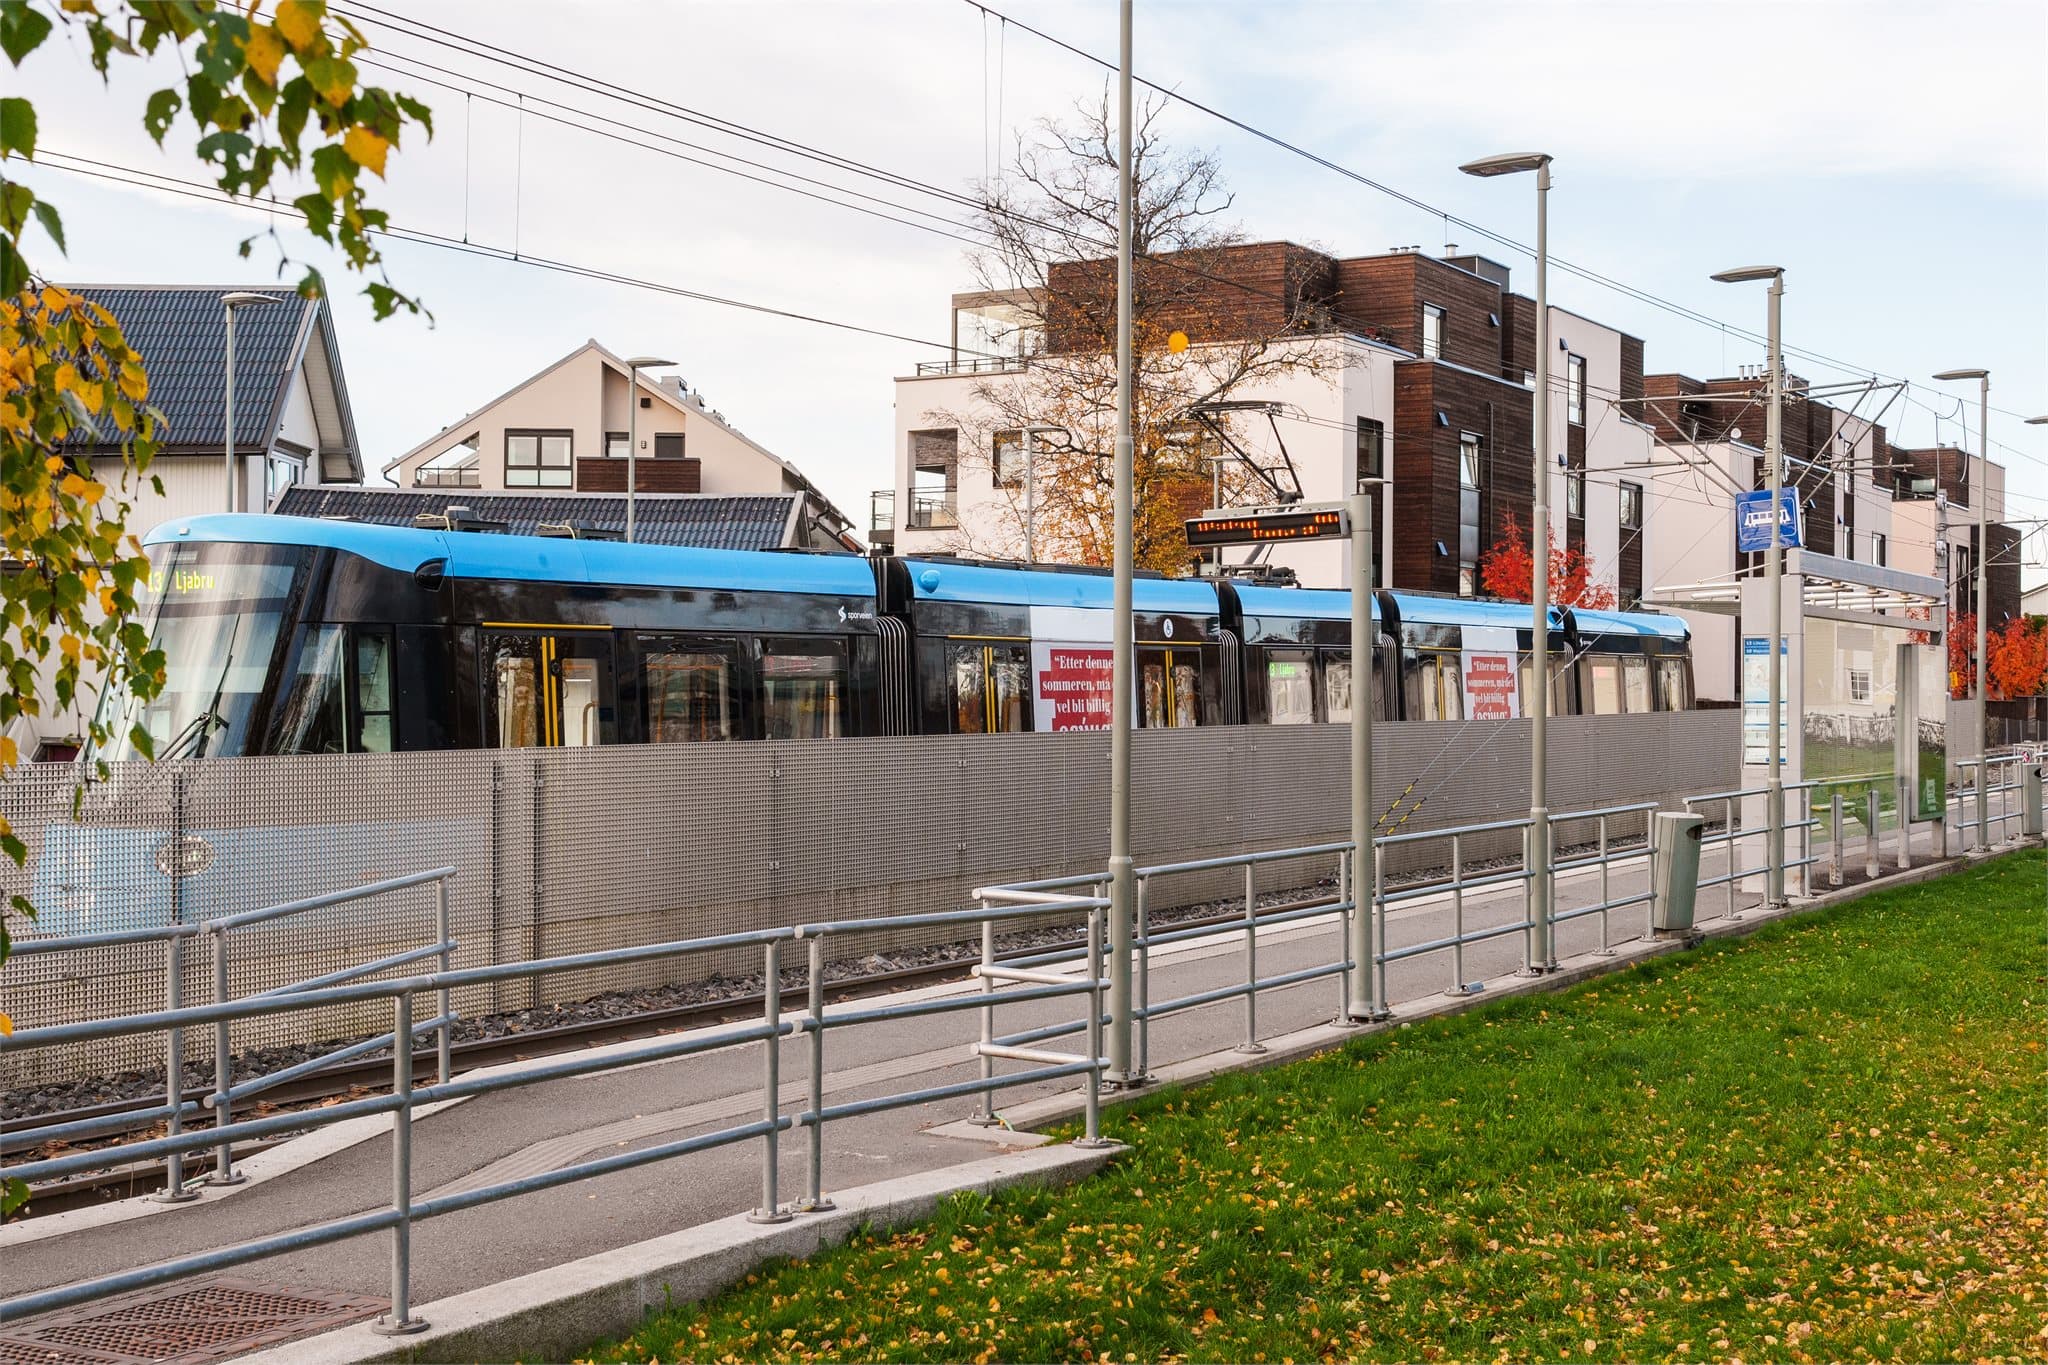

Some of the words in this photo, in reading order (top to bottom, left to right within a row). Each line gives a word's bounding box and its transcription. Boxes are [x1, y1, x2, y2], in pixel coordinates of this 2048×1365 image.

[176, 571, 214, 594] Ljabru
[847, 612, 873, 621] sporveien
[1085, 655, 1113, 669] denne
[1042, 680, 1095, 691] sommeren,
[1096, 676, 1111, 691] må
[1056, 699, 1070, 713] vel
[1072, 699, 1085, 713] bli
[1086, 698, 1111, 716] billig
